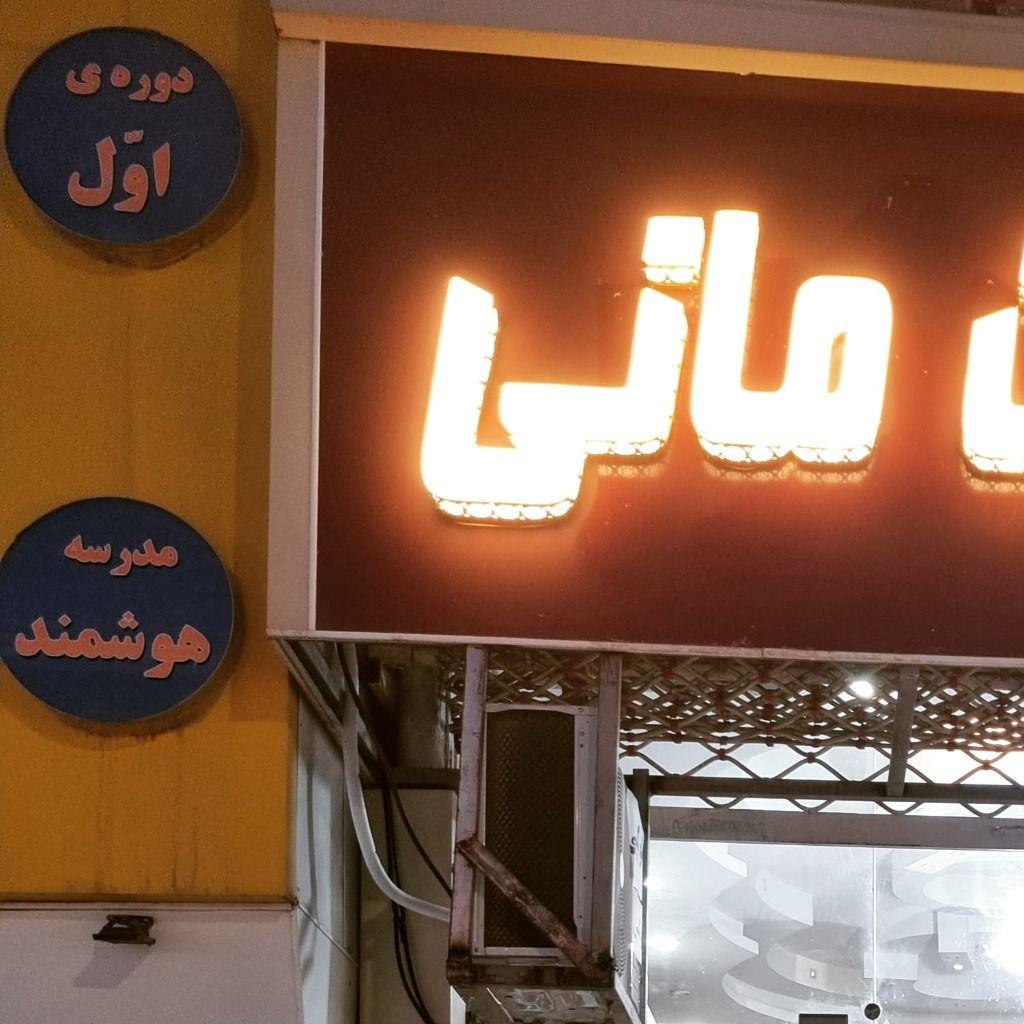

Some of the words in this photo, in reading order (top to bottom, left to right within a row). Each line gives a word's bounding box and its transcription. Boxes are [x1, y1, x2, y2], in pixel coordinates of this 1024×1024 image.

[420, 208, 894, 522] مانی
[64, 534, 179, 576] مدرسه
[15, 610, 211, 678] هوشمند
